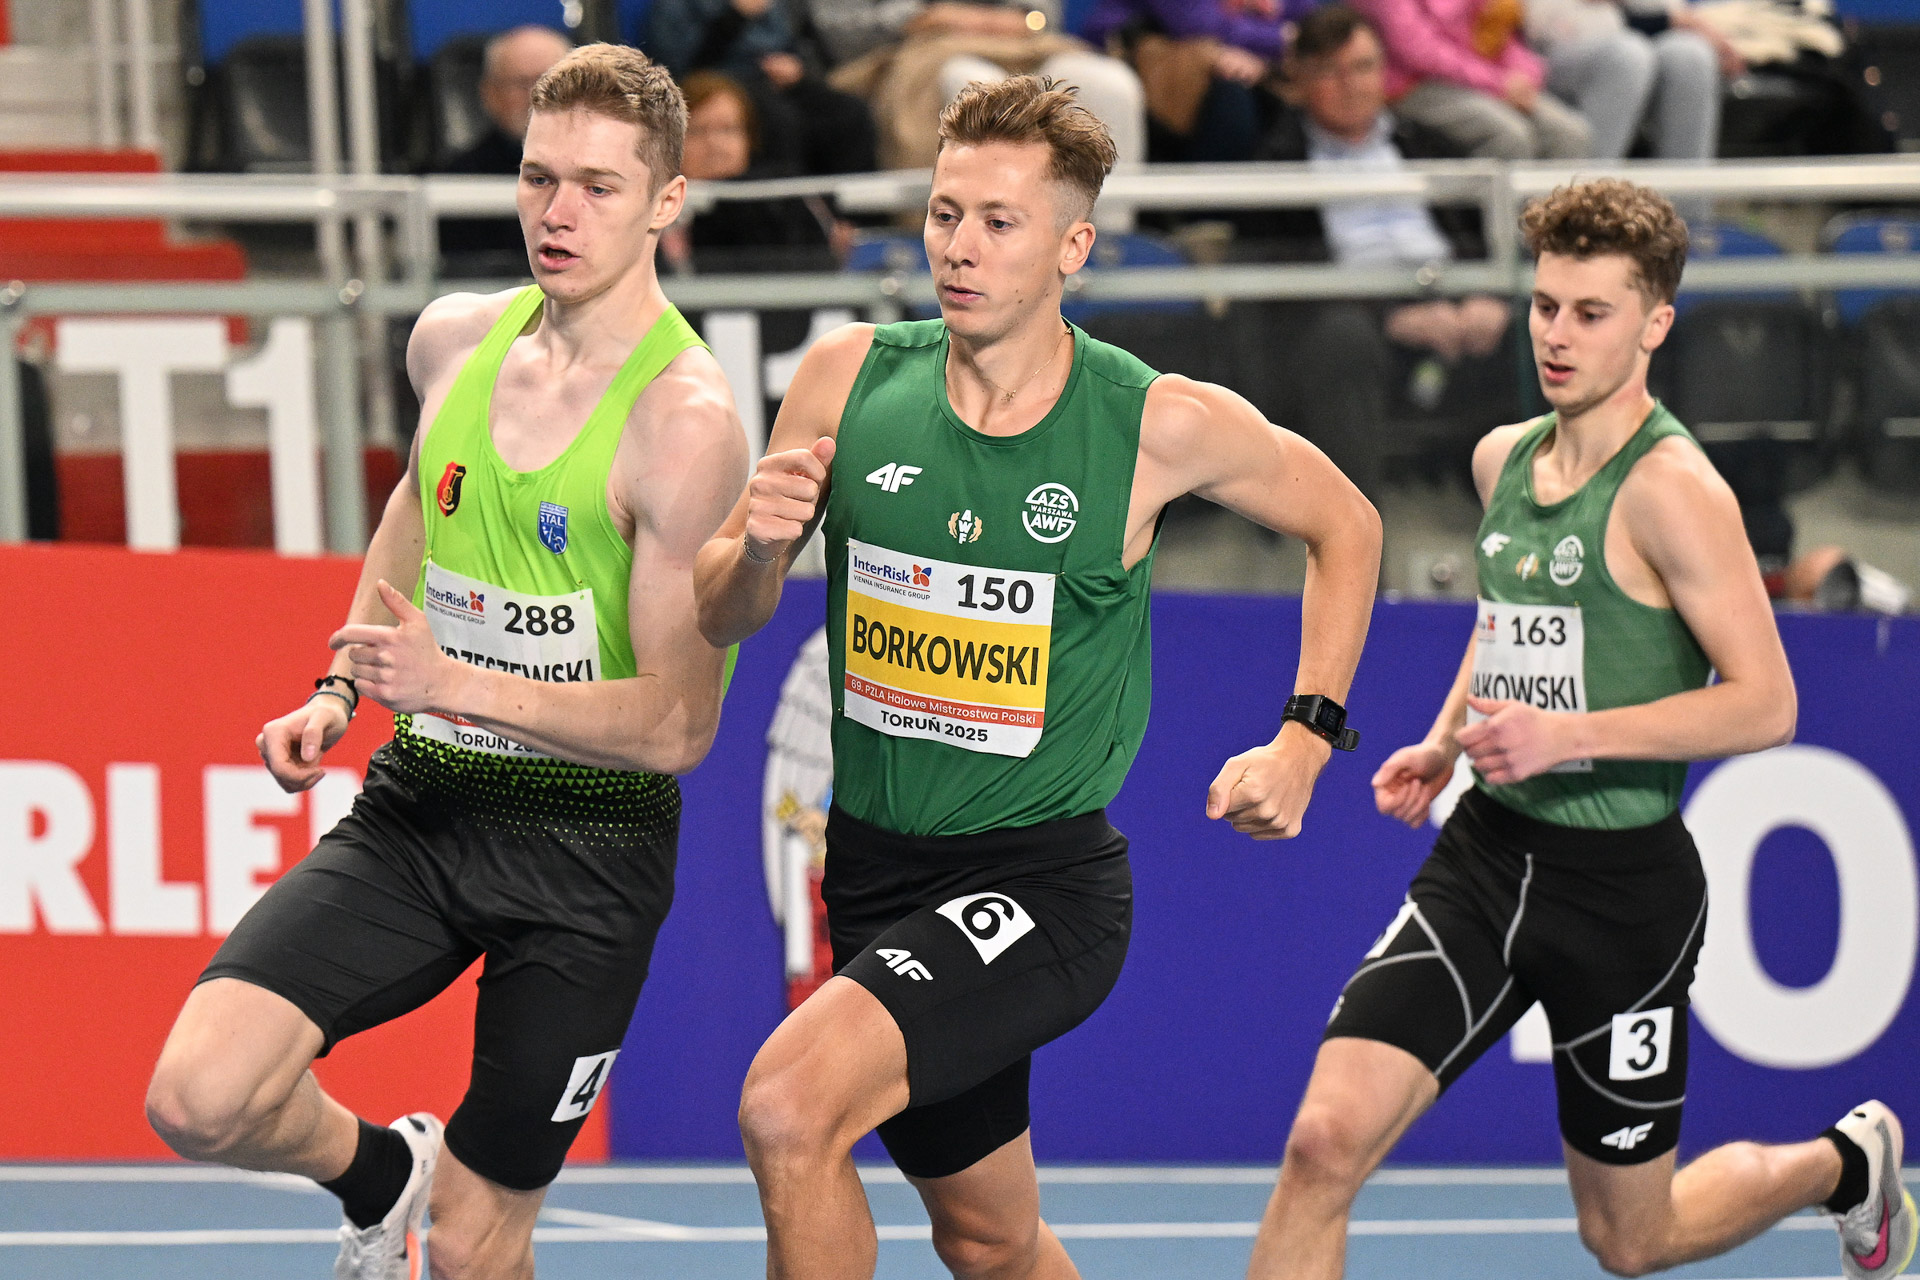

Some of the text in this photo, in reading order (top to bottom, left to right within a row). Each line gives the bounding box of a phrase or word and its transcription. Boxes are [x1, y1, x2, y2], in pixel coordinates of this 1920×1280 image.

[56, 318, 323, 555] T1
[866, 462, 923, 493] 4F
[1030, 504, 1073, 518] WARSZAWA
[1037, 491, 1070, 510] AZS
[540, 512, 564, 527] STAL
[1030, 513, 1069, 532] AWF
[853, 555, 910, 584] InterRisk
[853, 574, 931, 601] VIENNA INSURANCE GROUP
[957, 573, 1034, 614] 150
[503, 601, 575, 636] 288
[1511, 615, 1567, 646] 163
[852, 613, 1040, 686] BORKOWSKI
[851, 679, 1036, 725] 69. PZLA Halowe Mistrzostwa Polski
[1471, 674, 1578, 710] AKOWSKI
[880, 710, 989, 743] TORUŃ 2025
[0, 759, 363, 937] RLE
[961, 896, 1015, 941] 6
[875, 948, 934, 981] 4F
[1626, 1018, 1658, 1072] 3
[569, 1057, 607, 1112] 4
[1600, 1121, 1655, 1150] 4F
